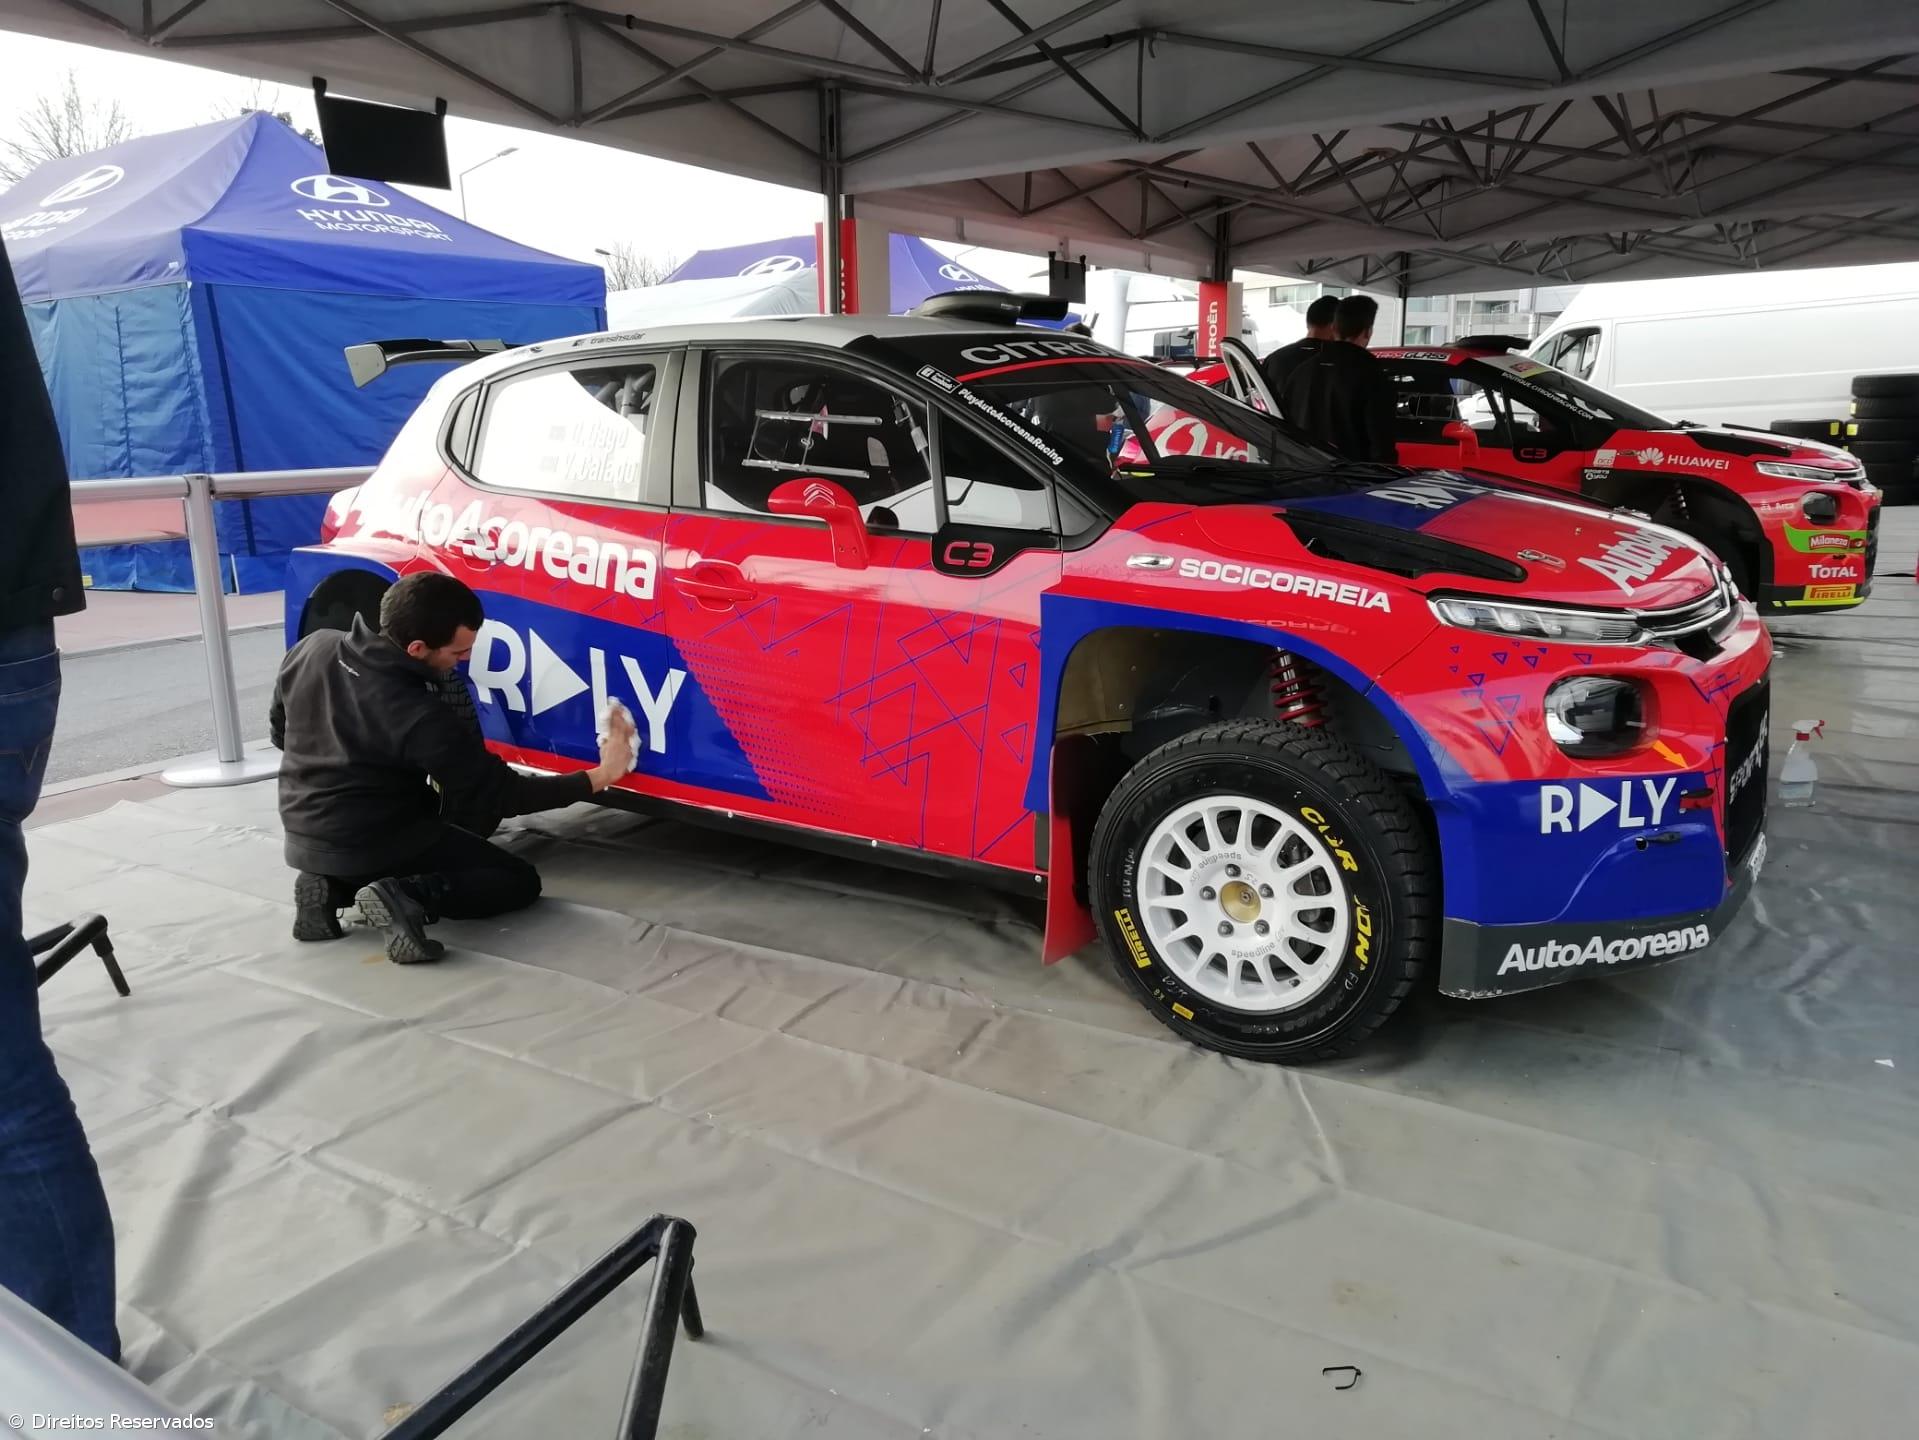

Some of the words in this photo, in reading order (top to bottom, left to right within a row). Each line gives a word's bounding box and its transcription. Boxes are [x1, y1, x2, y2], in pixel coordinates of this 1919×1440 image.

[296, 209, 443, 233] HYUNDAI
[314, 221, 453, 242] MOTORSPORT
[1520, 447, 1547, 459] C3
[1667, 454, 1730, 470] HUAWEI
[1810, 535, 1849, 548] Milaneza
[943, 541, 995, 568] C3
[1808, 564, 1858, 579] TOTAL
[1179, 557, 1392, 613] SOCICORREIA
[1809, 587, 1852, 599] PIRELLI
[1114, 907, 1152, 968] PIRELLI
[1497, 924, 1710, 976] AutoAçoreana
